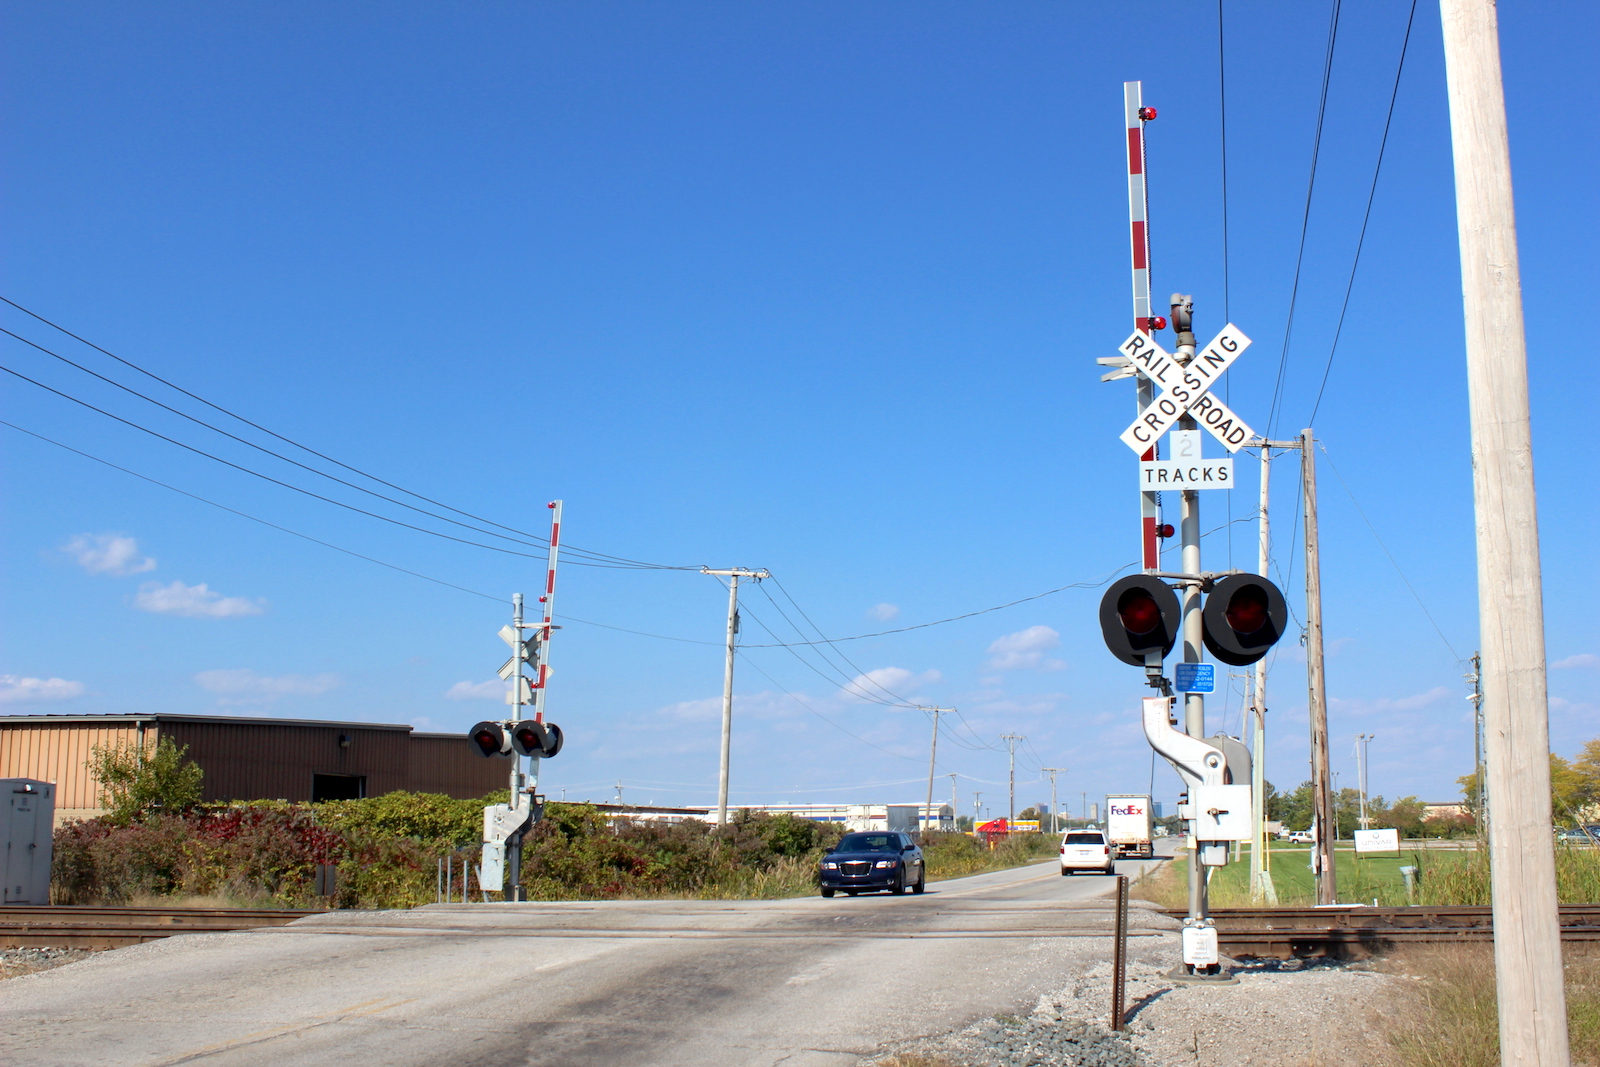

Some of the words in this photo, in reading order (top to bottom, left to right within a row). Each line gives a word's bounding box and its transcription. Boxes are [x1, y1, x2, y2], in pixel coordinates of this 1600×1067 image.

[1125, 335, 1171, 383] RAIL
[1192, 396, 1245, 445] ROAD
[1133, 336, 1238, 443] CROSSING
[1179, 438, 1193, 458] 2
[1145, 466, 1228, 483] TRACKS
[1111, 805, 1143, 815] FedEx
